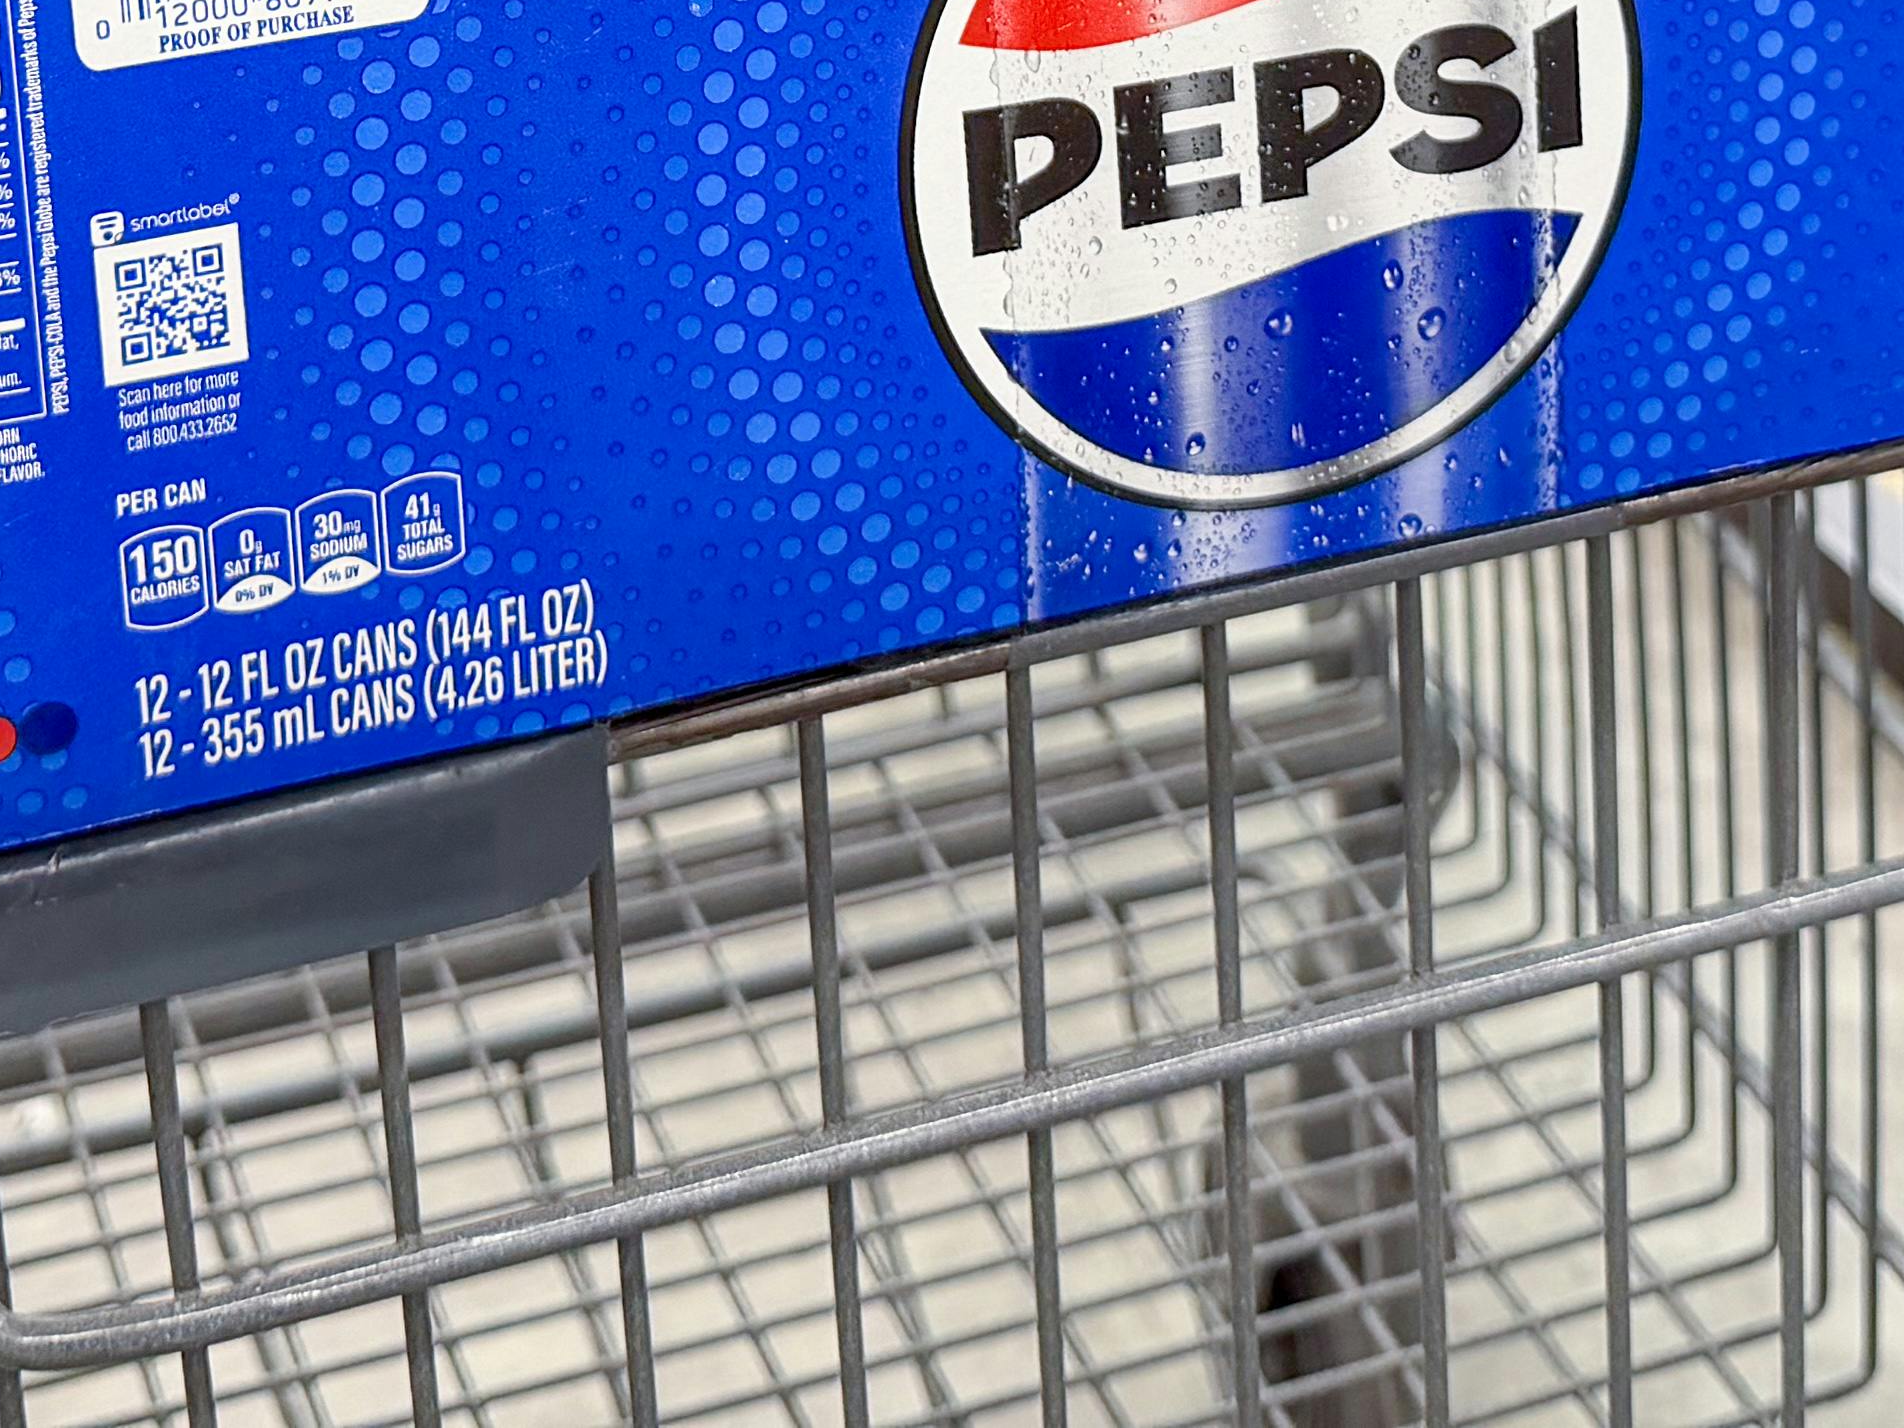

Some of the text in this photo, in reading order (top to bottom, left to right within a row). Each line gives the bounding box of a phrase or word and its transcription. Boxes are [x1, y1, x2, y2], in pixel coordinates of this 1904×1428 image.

[158, 4, 355, 53] PROOF OF PURCHASE
[962, 4, 1584, 259] PEPSI
[116, 477, 207, 518] PER CAN
[128, 535, 196, 585] 150
[130, 575, 201, 605] CALORIES
[135, 674, 171, 727] 12
[198, 660, 233, 712] 12
[241, 650, 279, 700] FL
[285, 638, 326, 690] OZ
[332, 618, 418, 678] CANS
[426, 608, 490, 665] (144
[500, 596, 536, 642] FL
[542, 579, 595, 637] OZ)
